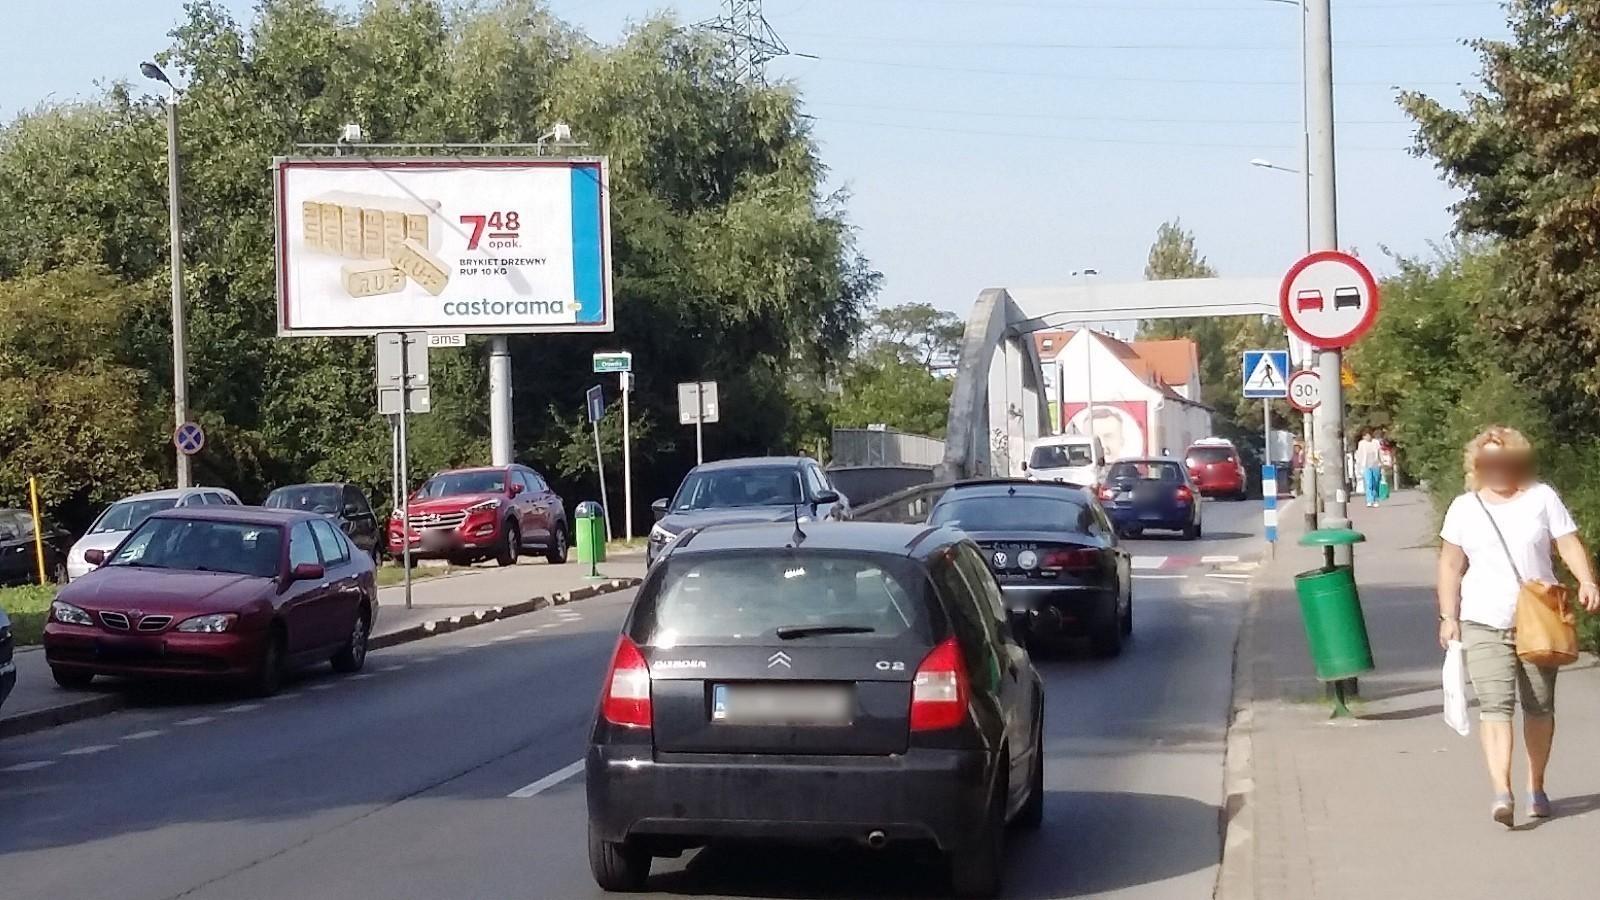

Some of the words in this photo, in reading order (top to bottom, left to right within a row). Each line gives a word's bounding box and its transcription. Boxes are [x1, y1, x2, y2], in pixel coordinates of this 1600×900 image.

[488, 239, 522, 250] opak.
[460, 258, 498, 266] BRYKIET
[500, 258, 547, 266] DRZEWNY
[460, 268, 478, 276] RUF
[481, 268, 492, 276] 10
[493, 268, 508, 276] KG
[443, 298, 564, 316] castorama
[431, 335, 461, 345] ams
[1295, 384, 1313, 397] 30
[875, 661, 905, 670] C2
